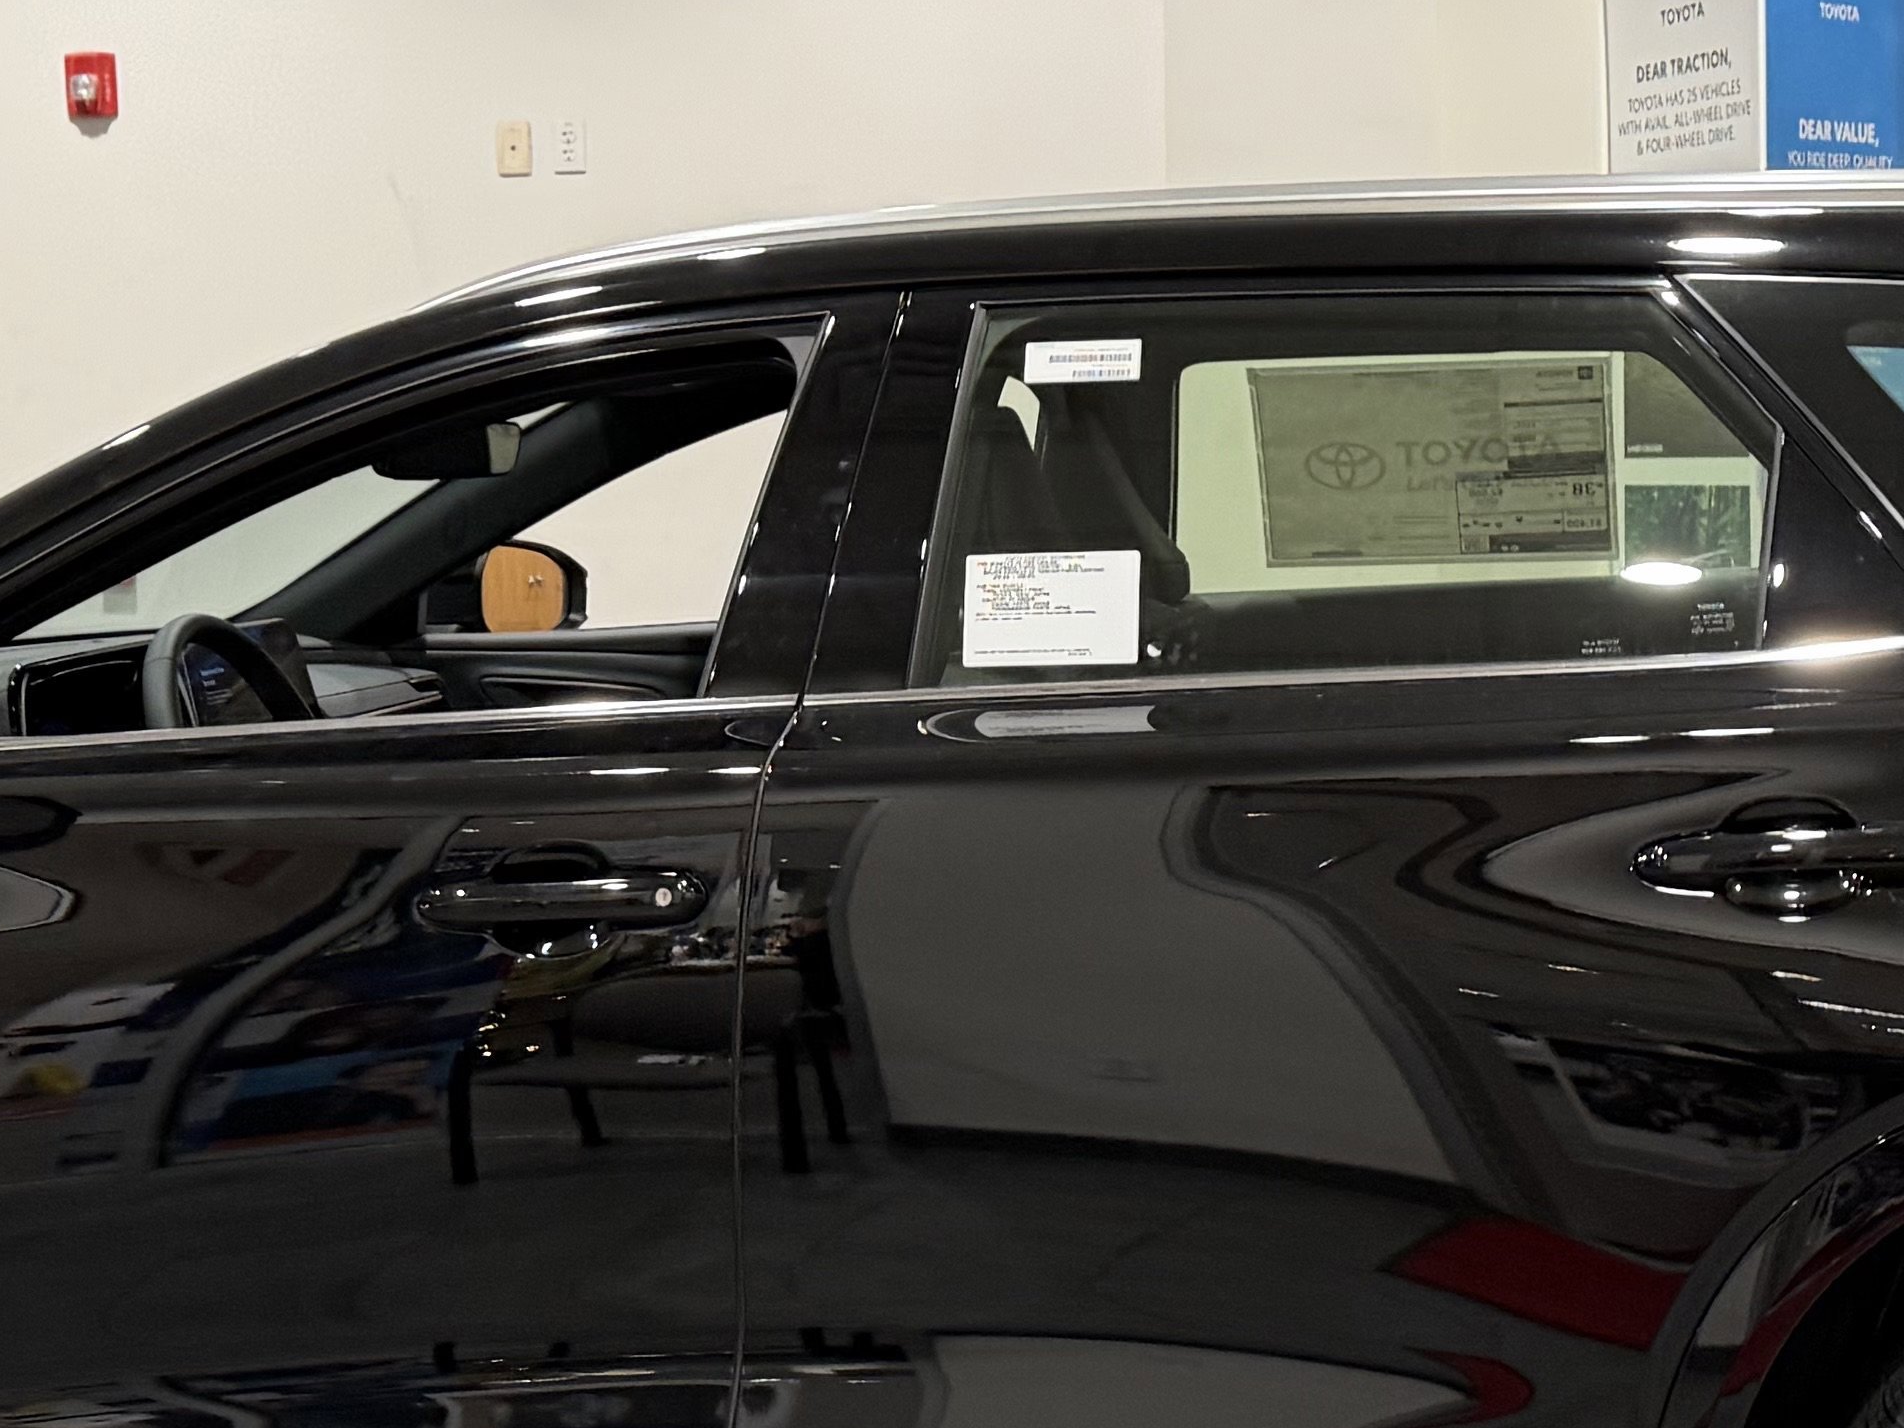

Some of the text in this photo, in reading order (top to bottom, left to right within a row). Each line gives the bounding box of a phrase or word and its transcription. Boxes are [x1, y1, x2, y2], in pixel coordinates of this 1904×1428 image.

[1661, 2, 1705, 27] TOYOTA
[1819, 2, 1860, 22] TOYOTA
[1636, 47, 1732, 84] DEAR TRACTION,
[1799, 118, 1879, 147] DEAR VALUE,
